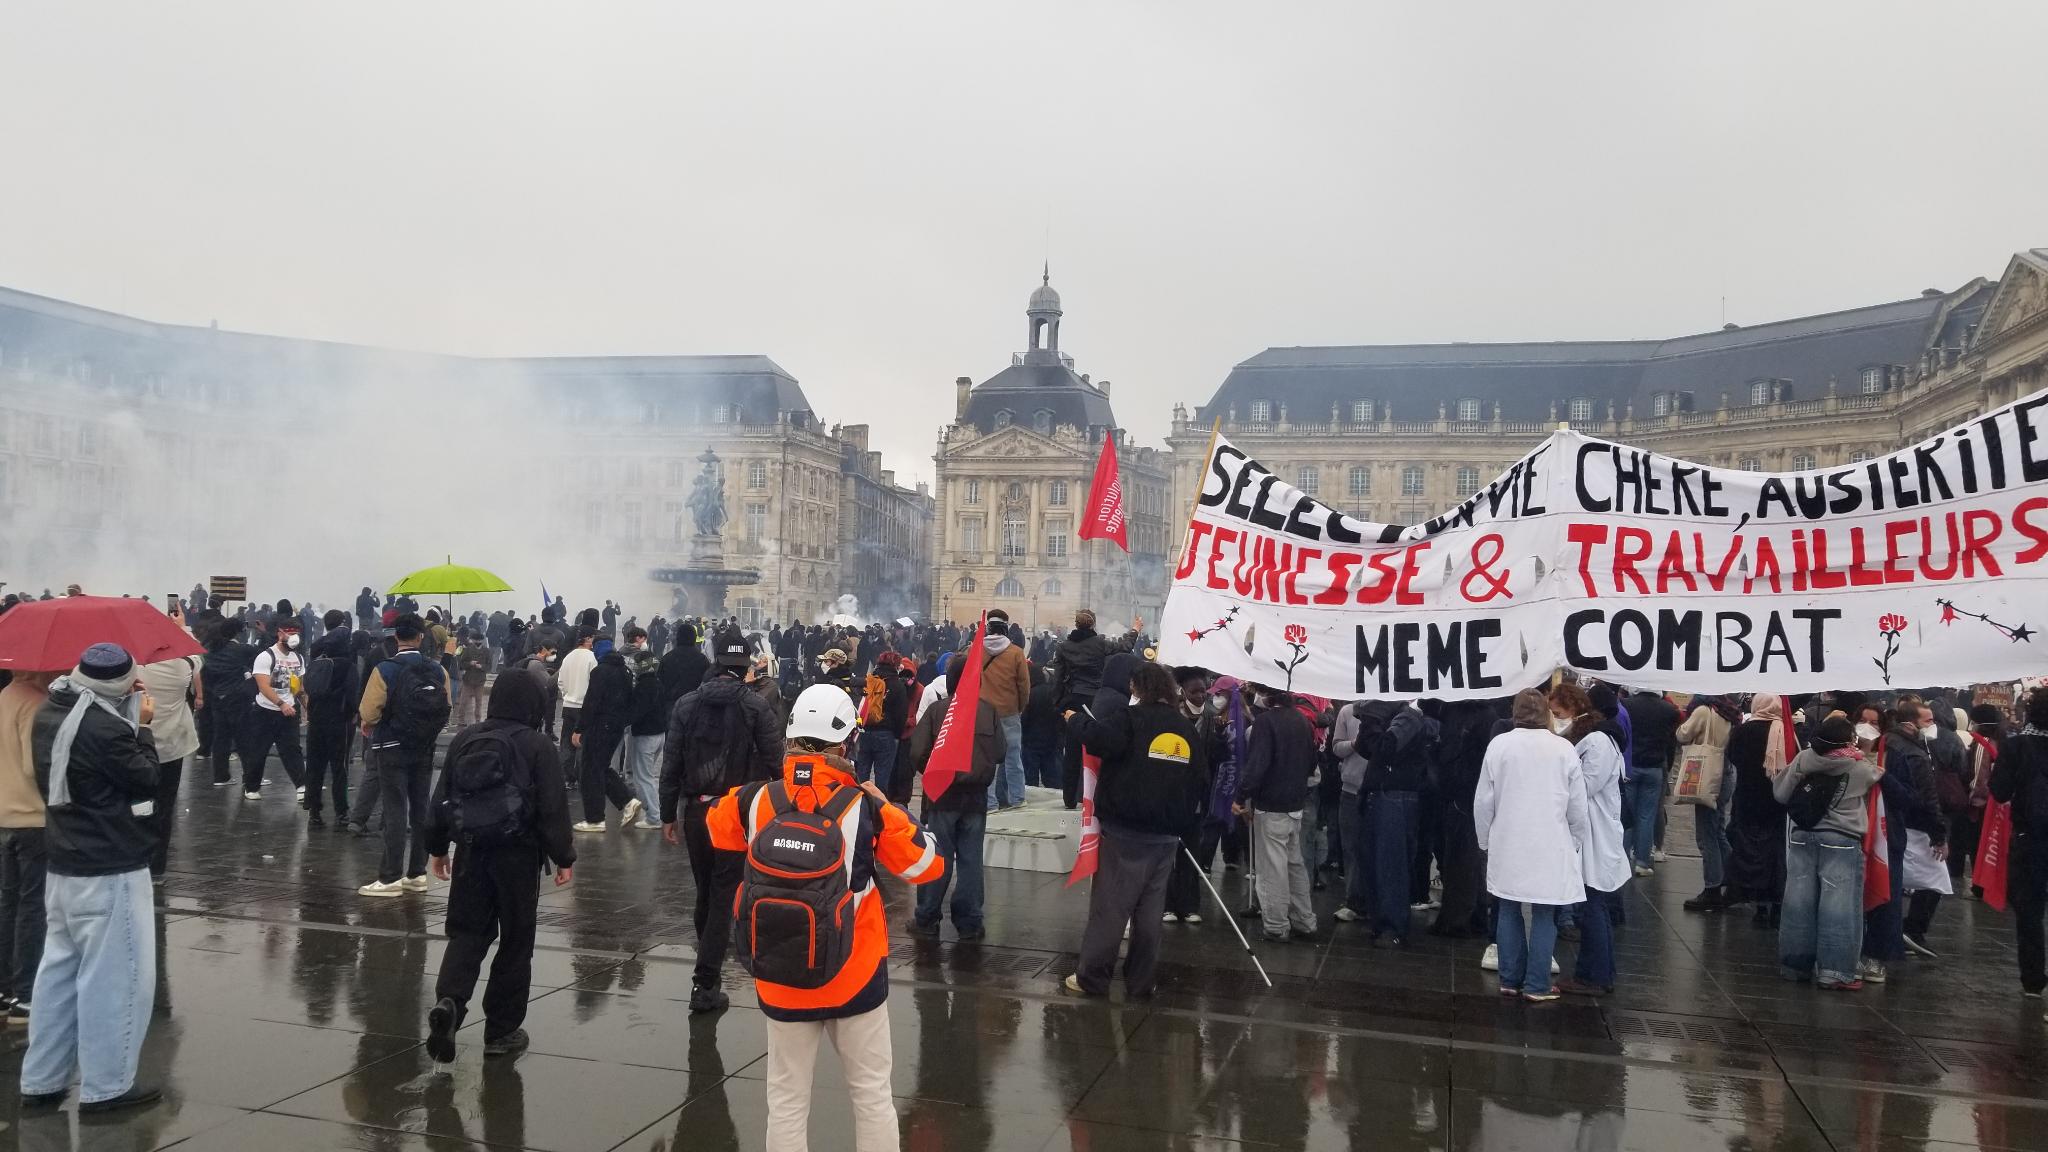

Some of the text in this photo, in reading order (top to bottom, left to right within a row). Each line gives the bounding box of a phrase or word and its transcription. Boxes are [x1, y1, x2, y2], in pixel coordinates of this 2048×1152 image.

[1488, 443, 1551, 518] VIE
[1175, 520, 1431, 605] JEUNESSE
[1459, 533, 1513, 602] &
[1355, 608, 1841, 693] MEME COMBAT
